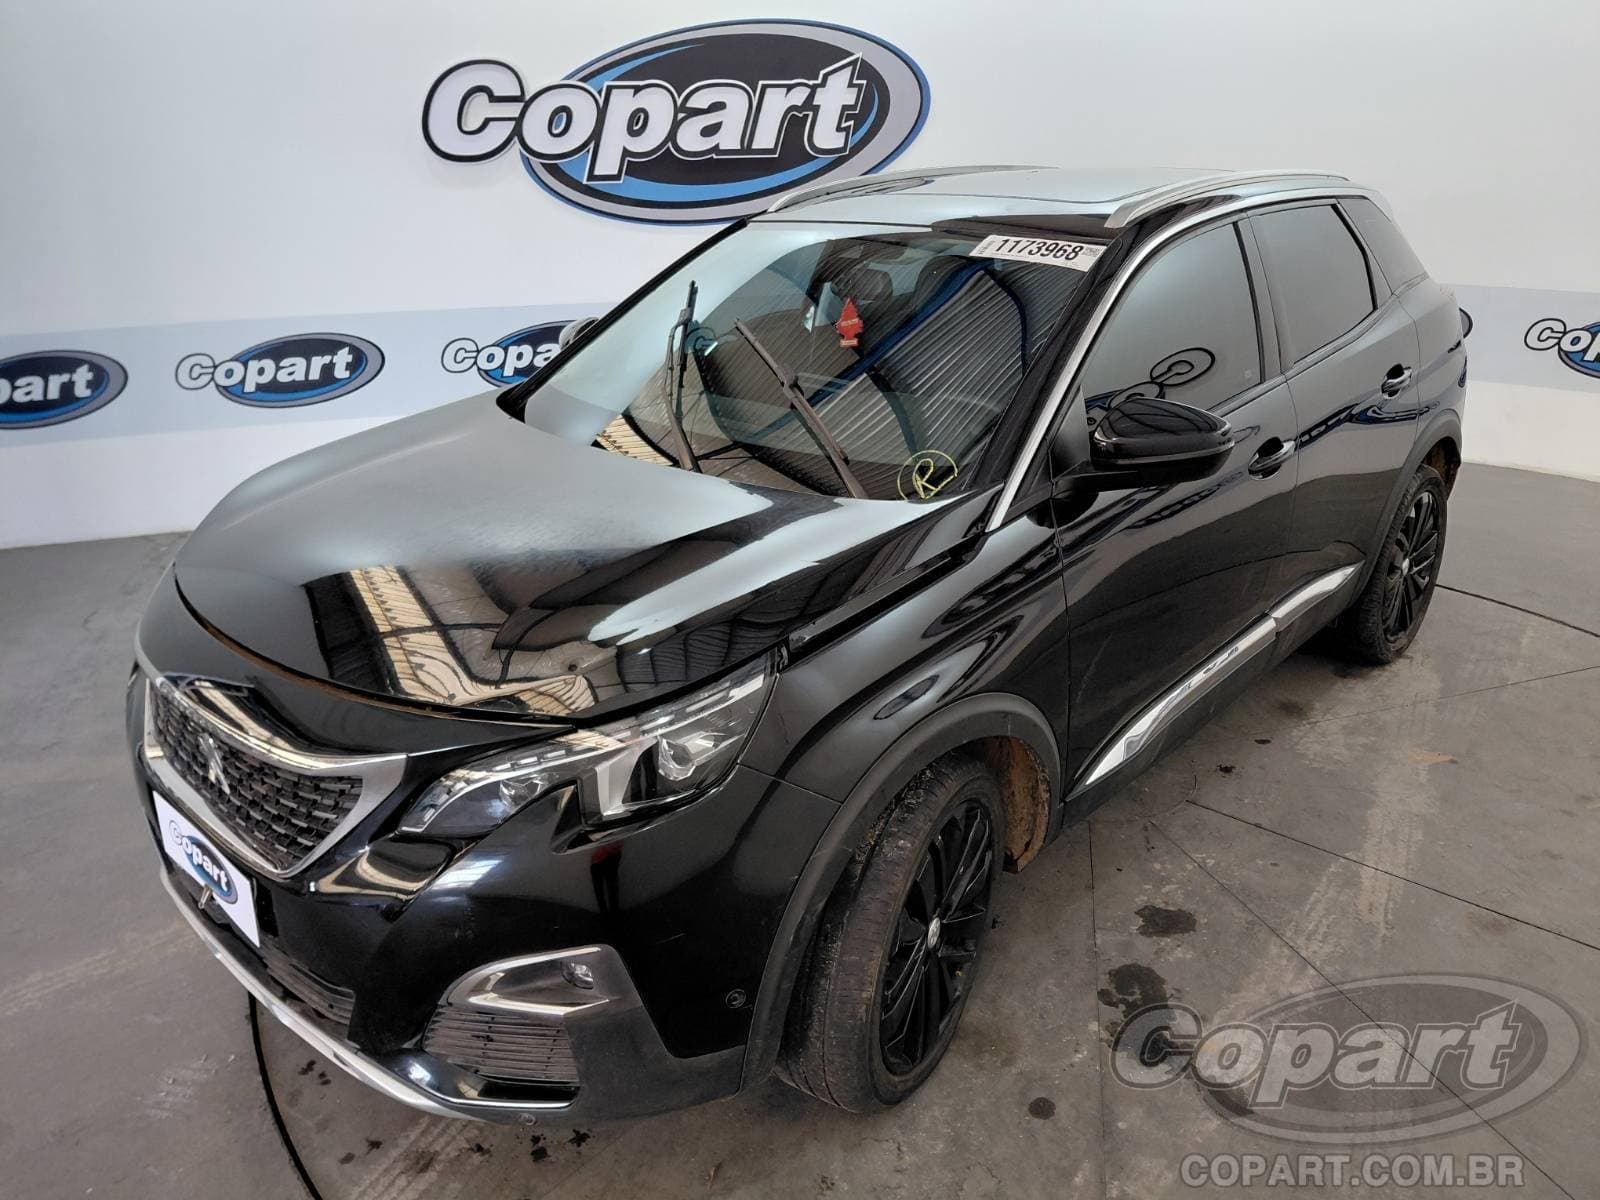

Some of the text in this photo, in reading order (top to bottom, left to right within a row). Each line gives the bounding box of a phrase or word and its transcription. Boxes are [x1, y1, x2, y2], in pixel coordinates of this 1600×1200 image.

[422, 52, 867, 183] Copart
[995, 238, 1085, 261] 1173968
[175, 346, 354, 394] Copart
[441, 337, 561, 377] Copa
[0, 363, 94, 405] art
[169, 820, 230, 892] Copart
